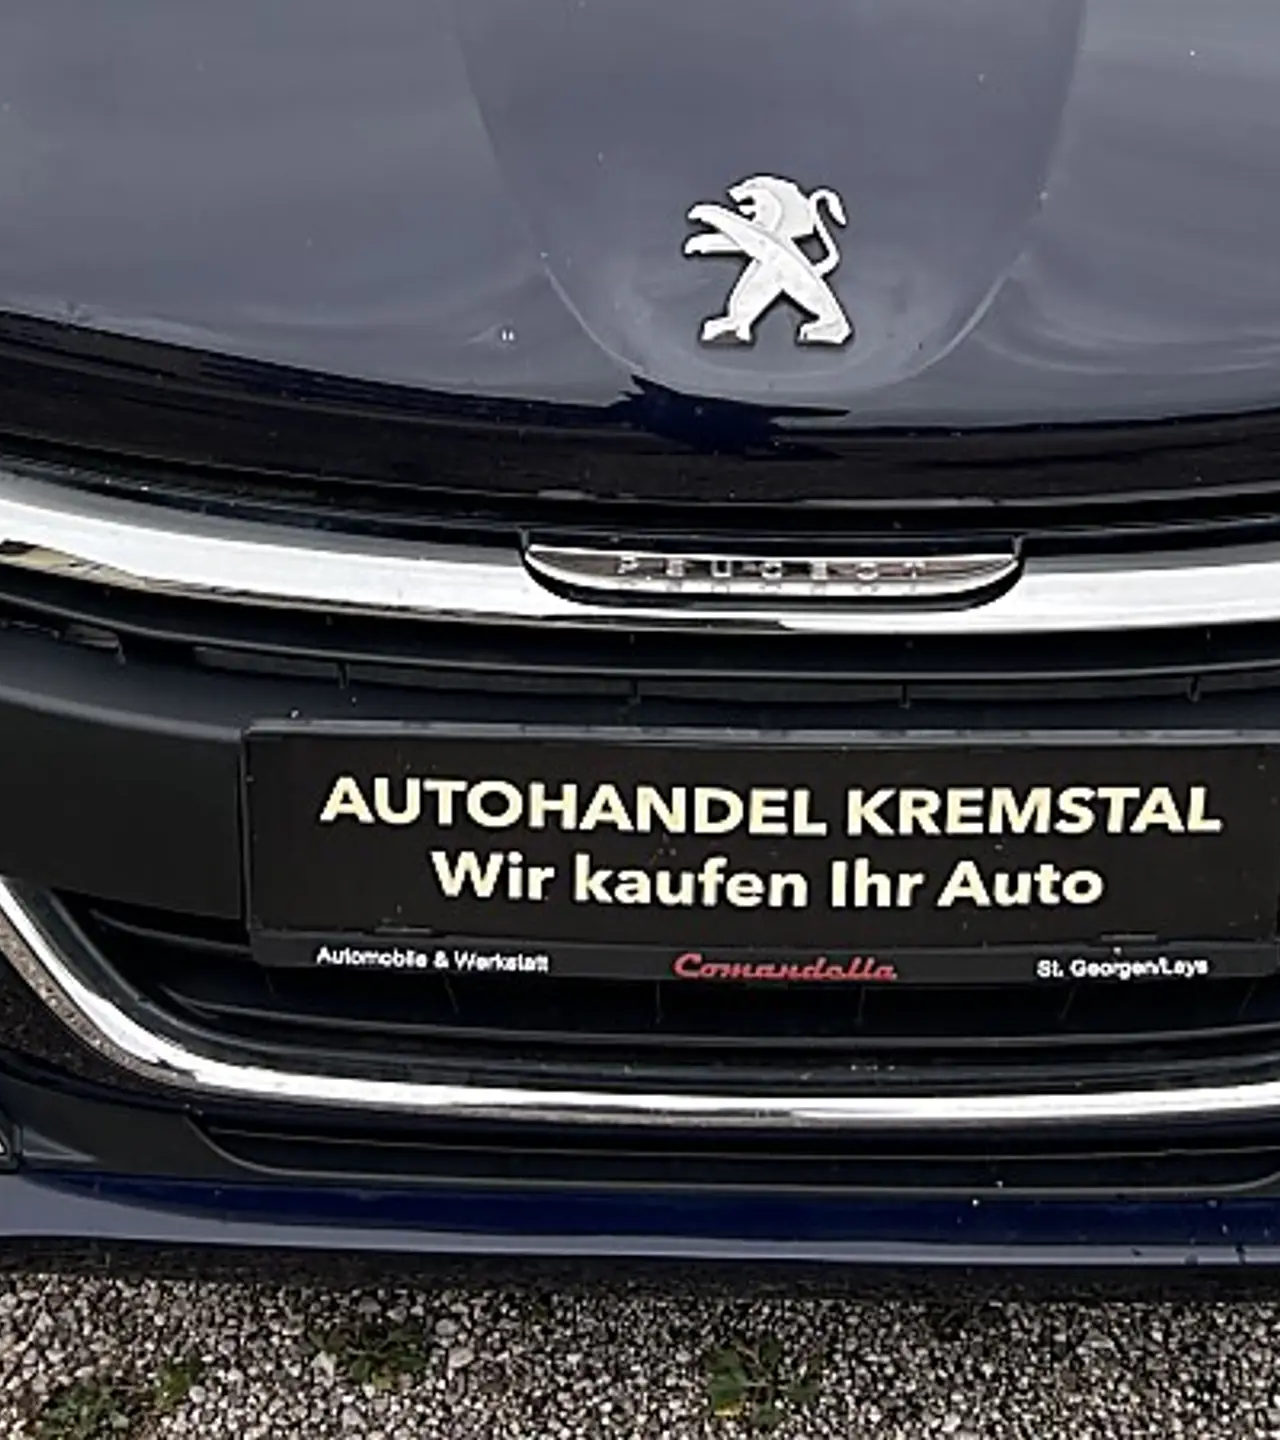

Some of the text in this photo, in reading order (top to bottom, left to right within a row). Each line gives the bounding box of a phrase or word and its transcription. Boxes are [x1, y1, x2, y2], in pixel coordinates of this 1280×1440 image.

[320, 776, 1222, 836] AUTOHANDEL KREMSTAL
[429, 850, 1104, 908] Wir kaufen Ihr Auto
[317, 946, 549, 973] Automobile & Werkstatt
[1037, 959, 1064, 978] St.
